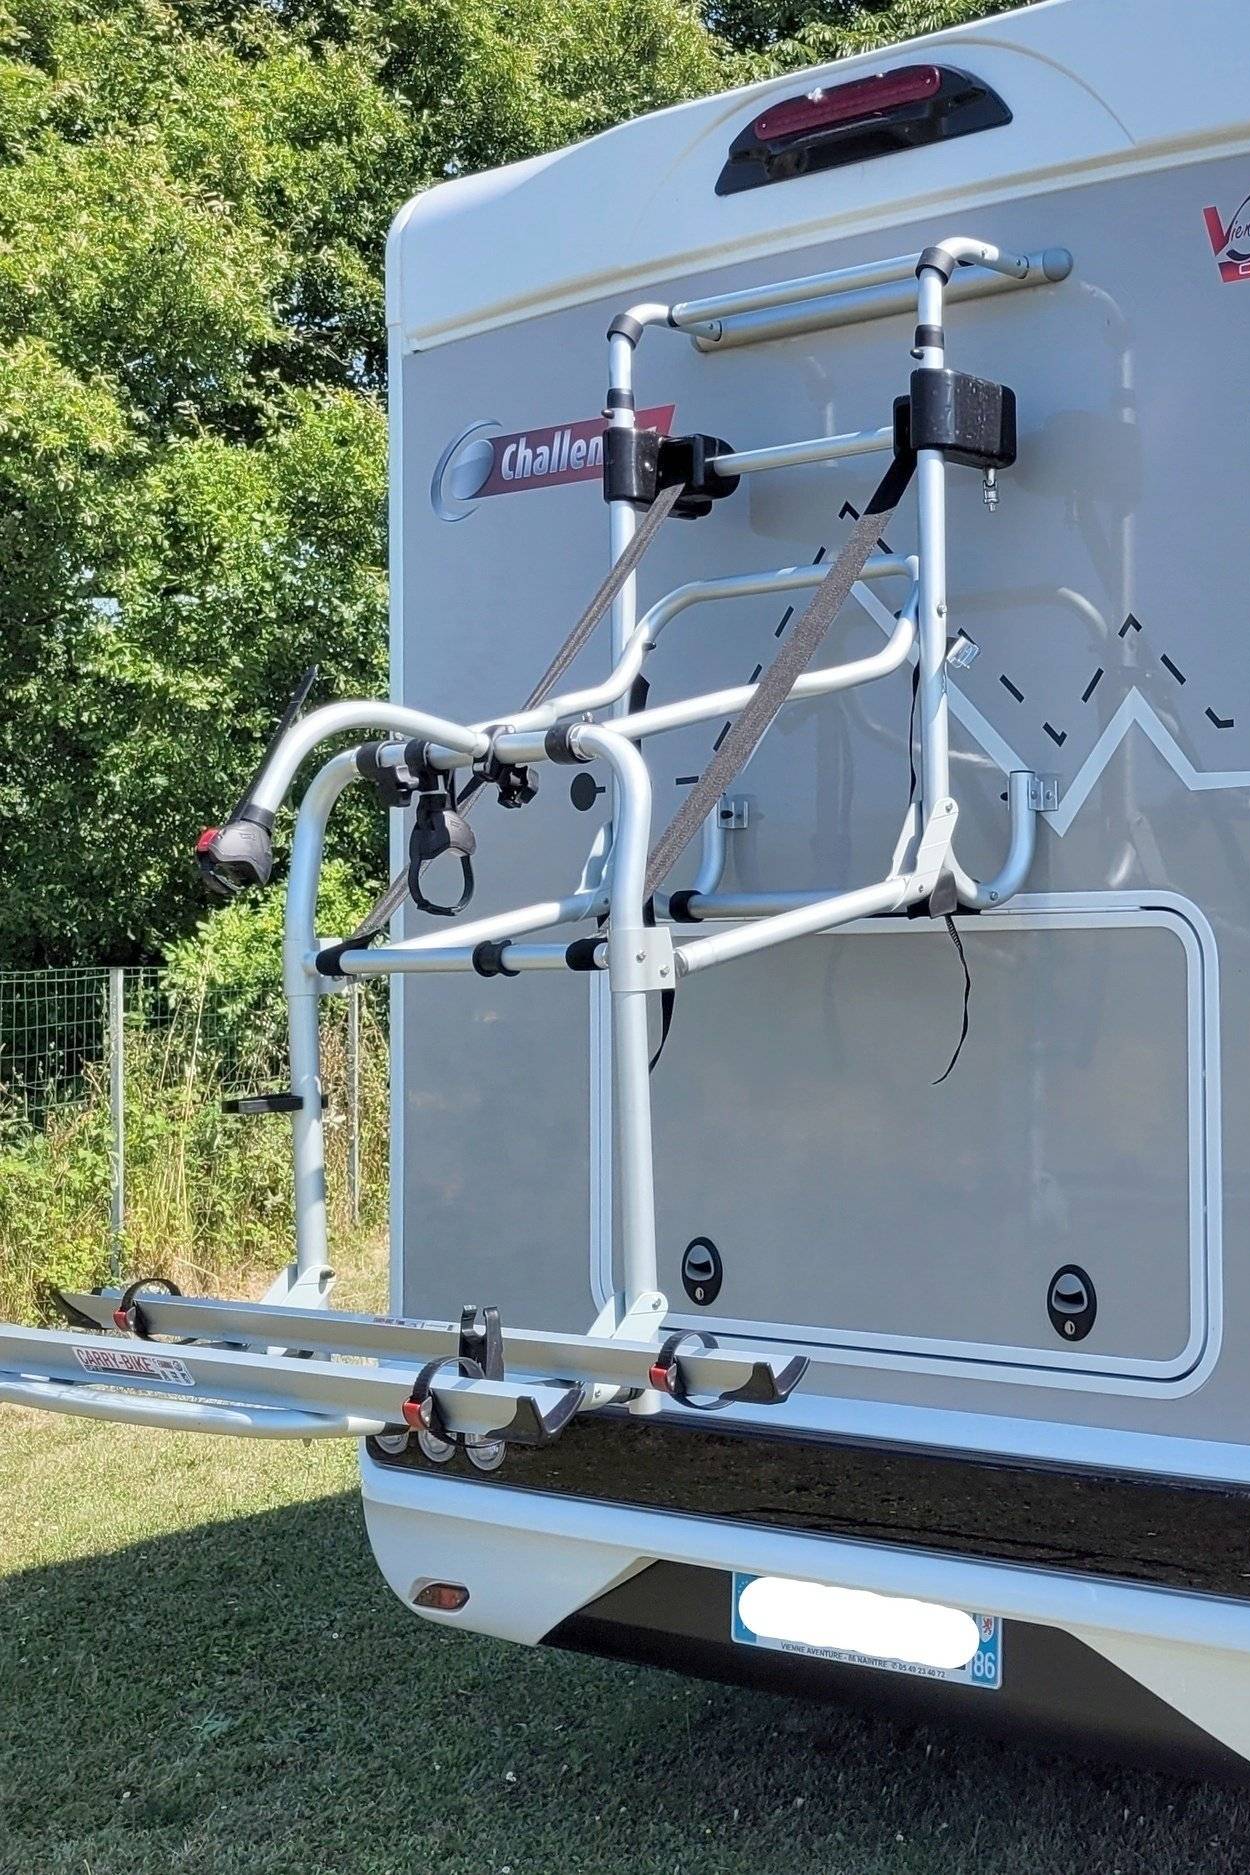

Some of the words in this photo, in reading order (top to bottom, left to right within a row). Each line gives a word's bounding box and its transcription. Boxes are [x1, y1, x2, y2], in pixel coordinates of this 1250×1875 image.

[501, 428, 603, 481] Challen
[77, 1349, 155, 1374] CARRY-BIKE
[781, 1641, 806, 1653] VIENNE
[806, 1647, 843, 1660] AVENTURE
[974, 1651, 996, 1679] 86
